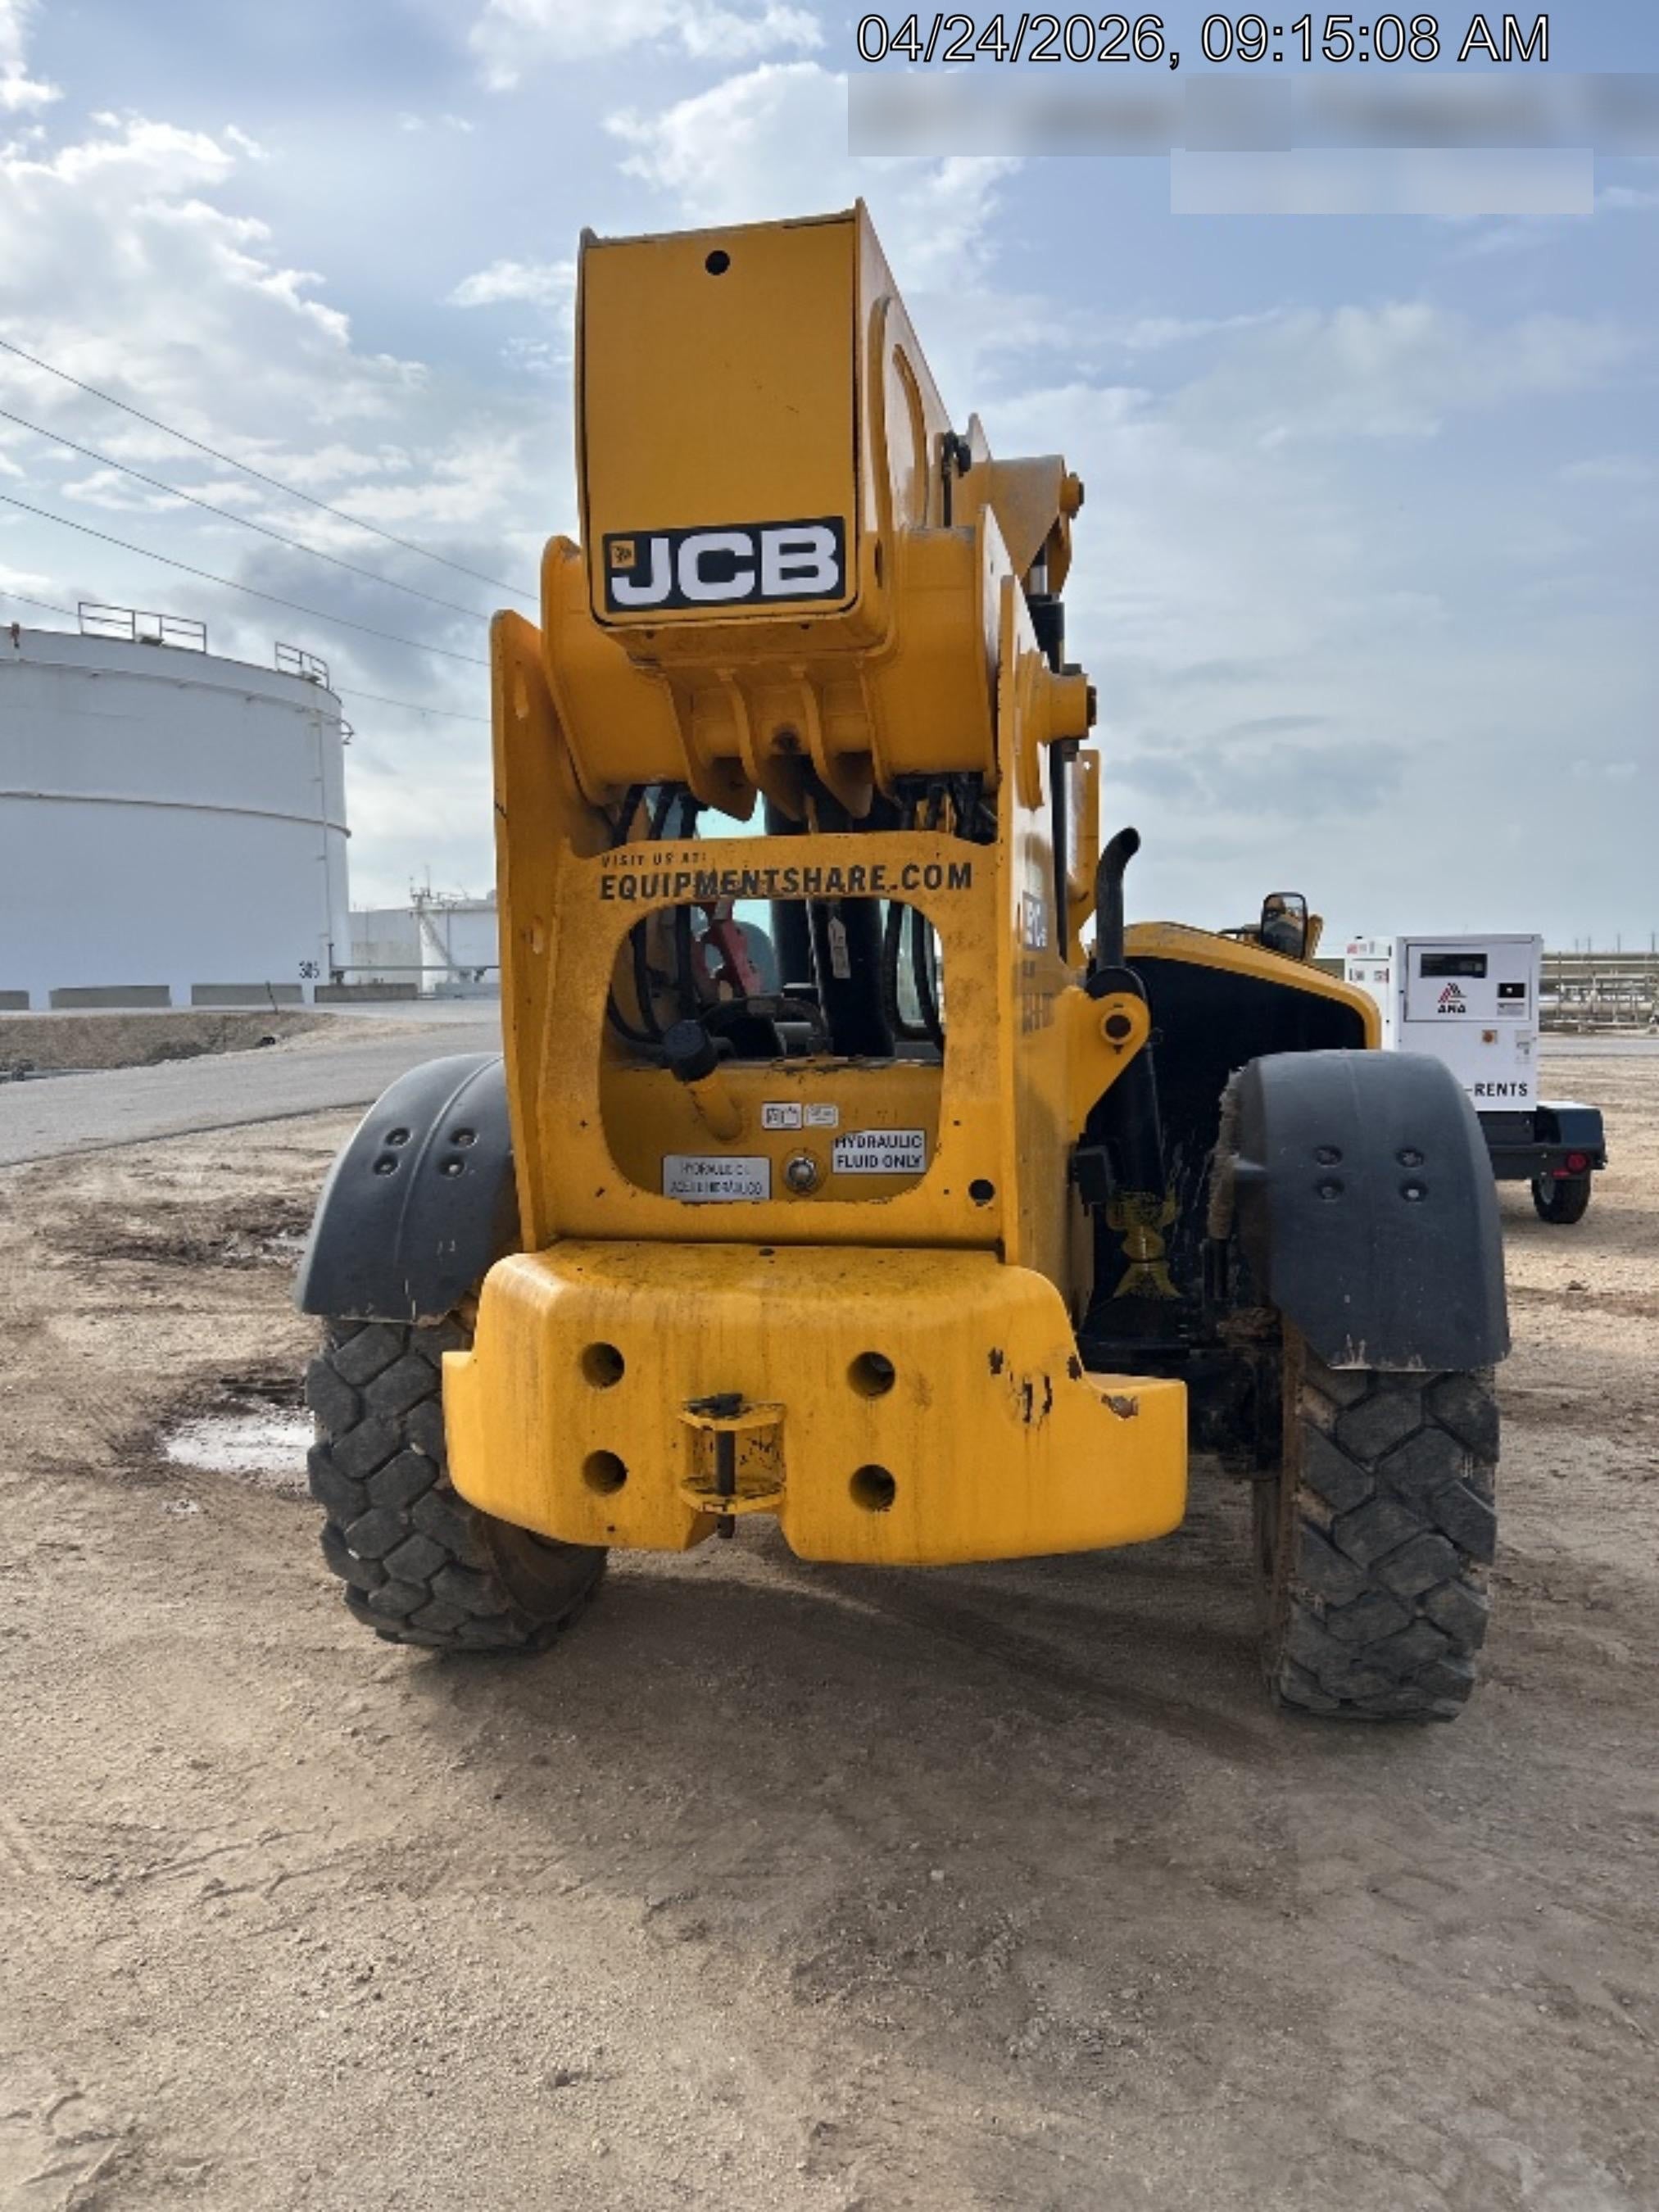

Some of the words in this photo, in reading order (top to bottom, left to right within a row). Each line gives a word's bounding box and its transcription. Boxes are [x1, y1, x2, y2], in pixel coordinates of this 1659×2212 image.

[611, 525, 839, 605] JCB
[602, 854, 644, 868] VISIT
[653, 852, 673, 865] US
[601, 863, 972, 900] EQUIPMENTSHARE.COM
[835, 1134, 922, 1149] HYDRAULIC
[837, 1154, 878, 1168] FLUID
[882, 1154, 922, 1168] ONLY
